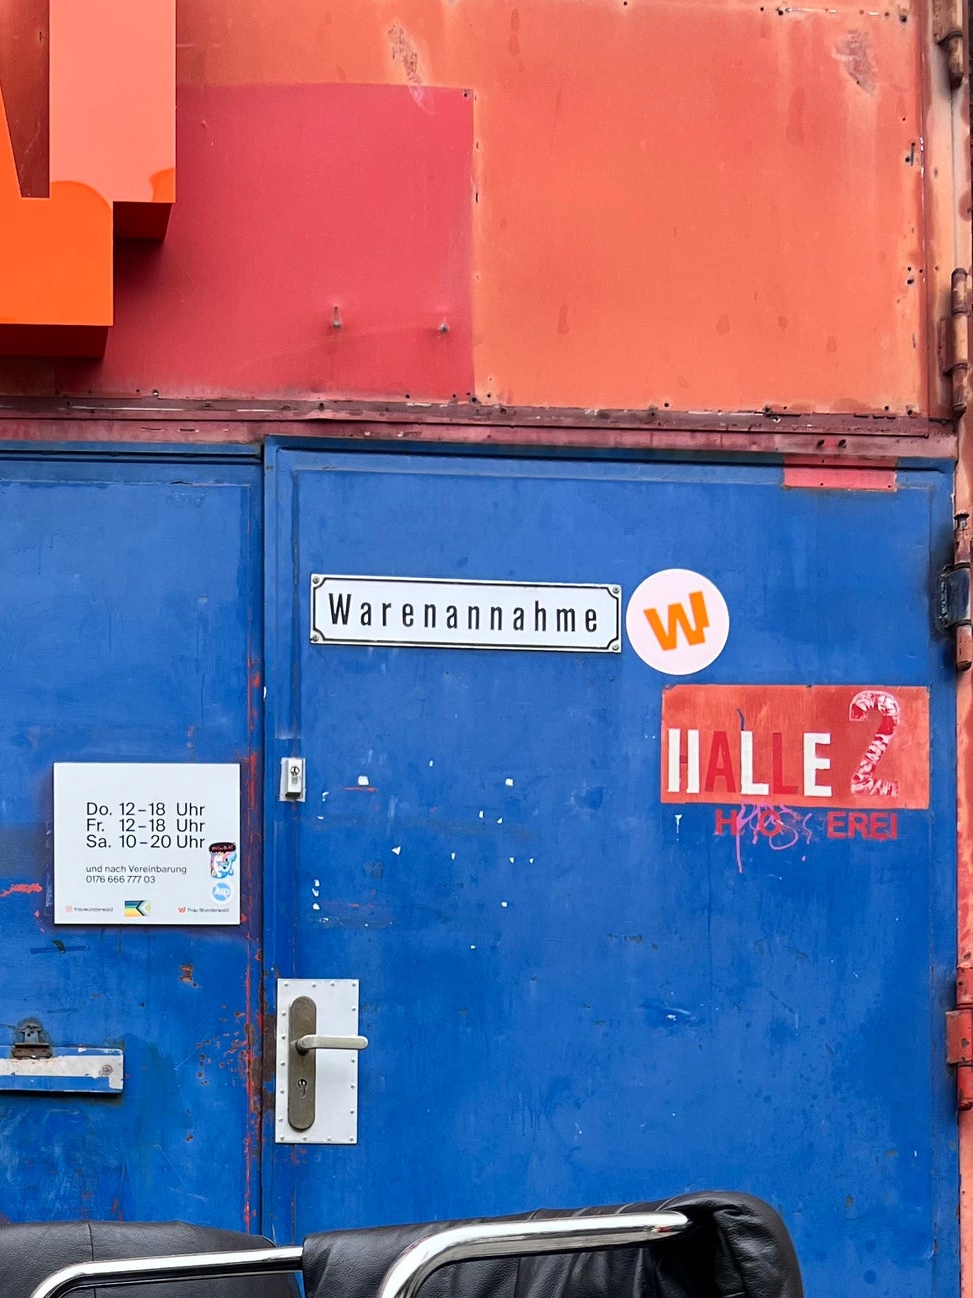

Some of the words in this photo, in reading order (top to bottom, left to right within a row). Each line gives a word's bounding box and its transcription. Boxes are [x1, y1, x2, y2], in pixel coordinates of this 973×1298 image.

[327, 592, 598, 633] Warenannahme
[643, 590, 710, 651] W
[667, 728, 832, 797] HALLE
[849, 690, 900, 797] 2
[86, 802, 112, 816] Do.
[176, 802, 205, 816] Uhr
[86, 818, 105, 832] Fr.
[176, 818, 205, 832] Uhr
[86, 834, 111, 848] Sa.
[176, 834, 205, 848] Uhr
[85, 865, 103, 873] und
[104, 865, 126, 873] nach
[128, 865, 187, 875] Vereinbarung
[85, 875, 106, 883] 0176
[107, 875, 125, 883] 666
[127, 875, 142, 883] 777
[143, 875, 156, 883] 03
